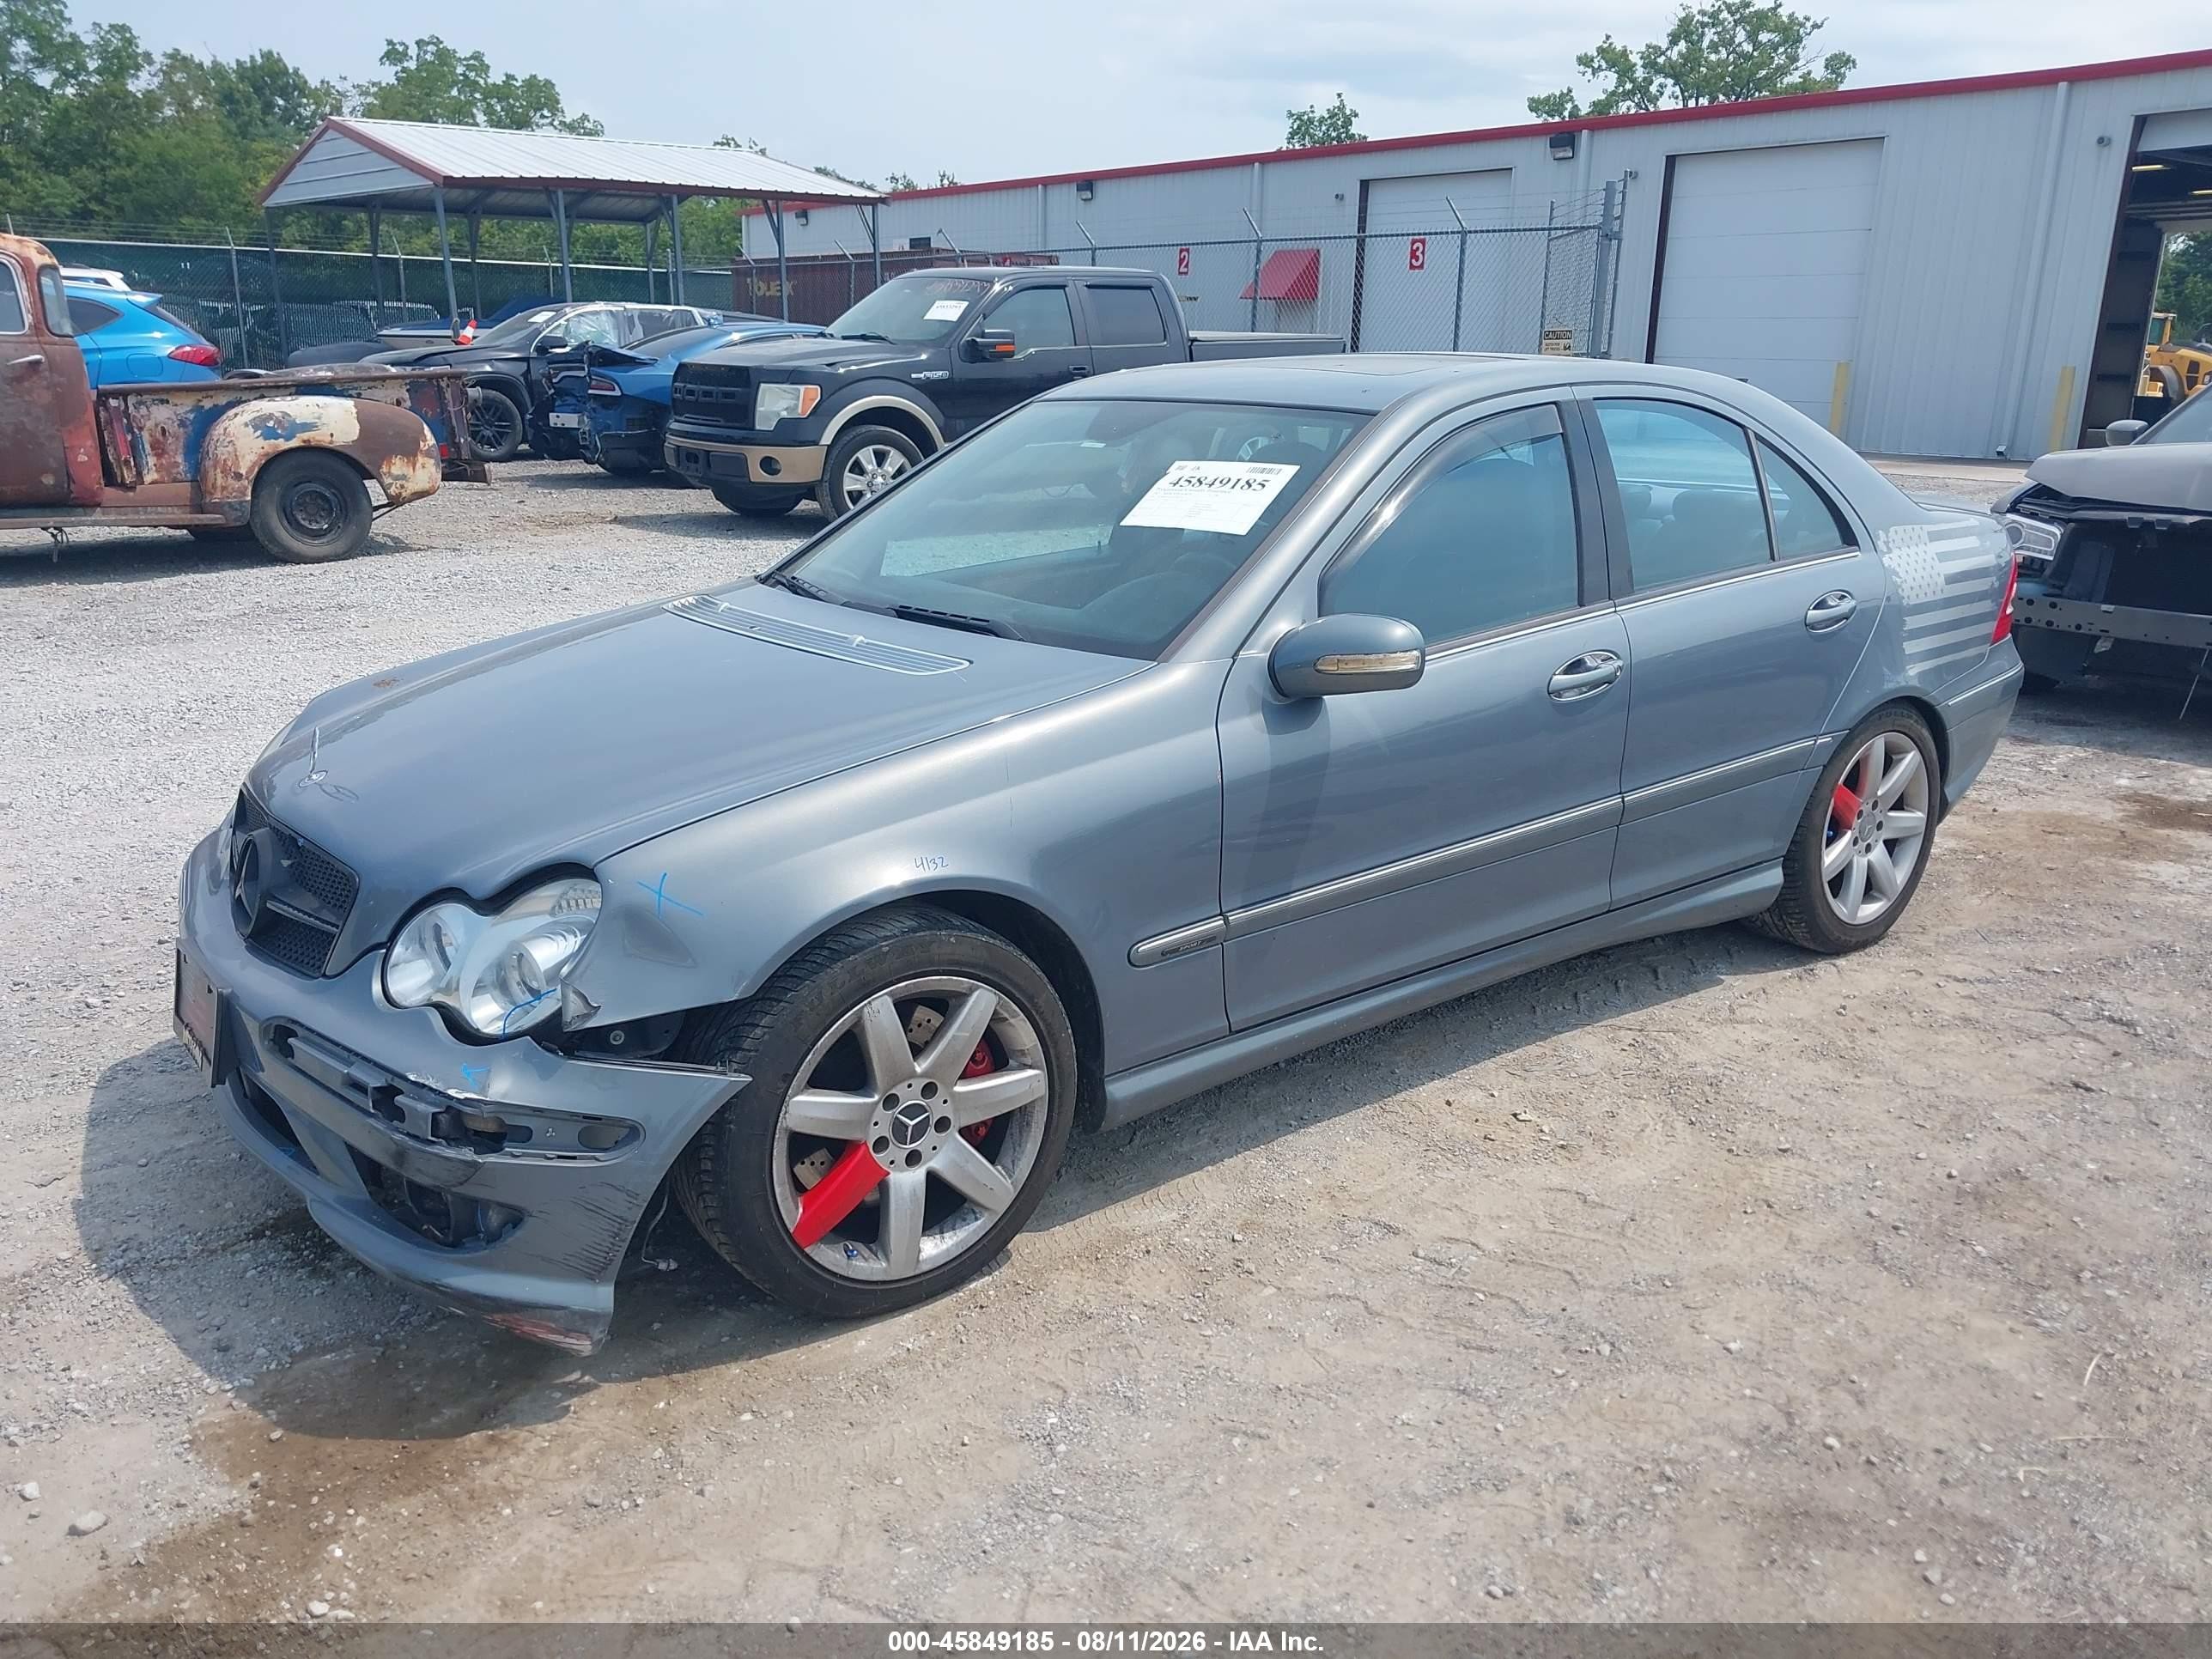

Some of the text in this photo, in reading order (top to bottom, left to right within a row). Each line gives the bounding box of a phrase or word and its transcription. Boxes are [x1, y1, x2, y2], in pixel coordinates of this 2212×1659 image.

[1179, 252, 1188, 273] 2
[1412, 242, 1424, 266] 3
[1544, 331, 1571, 339] CAUTION
[1169, 475, 1272, 492] 45849185
[914, 855, 949, 873] 4132
